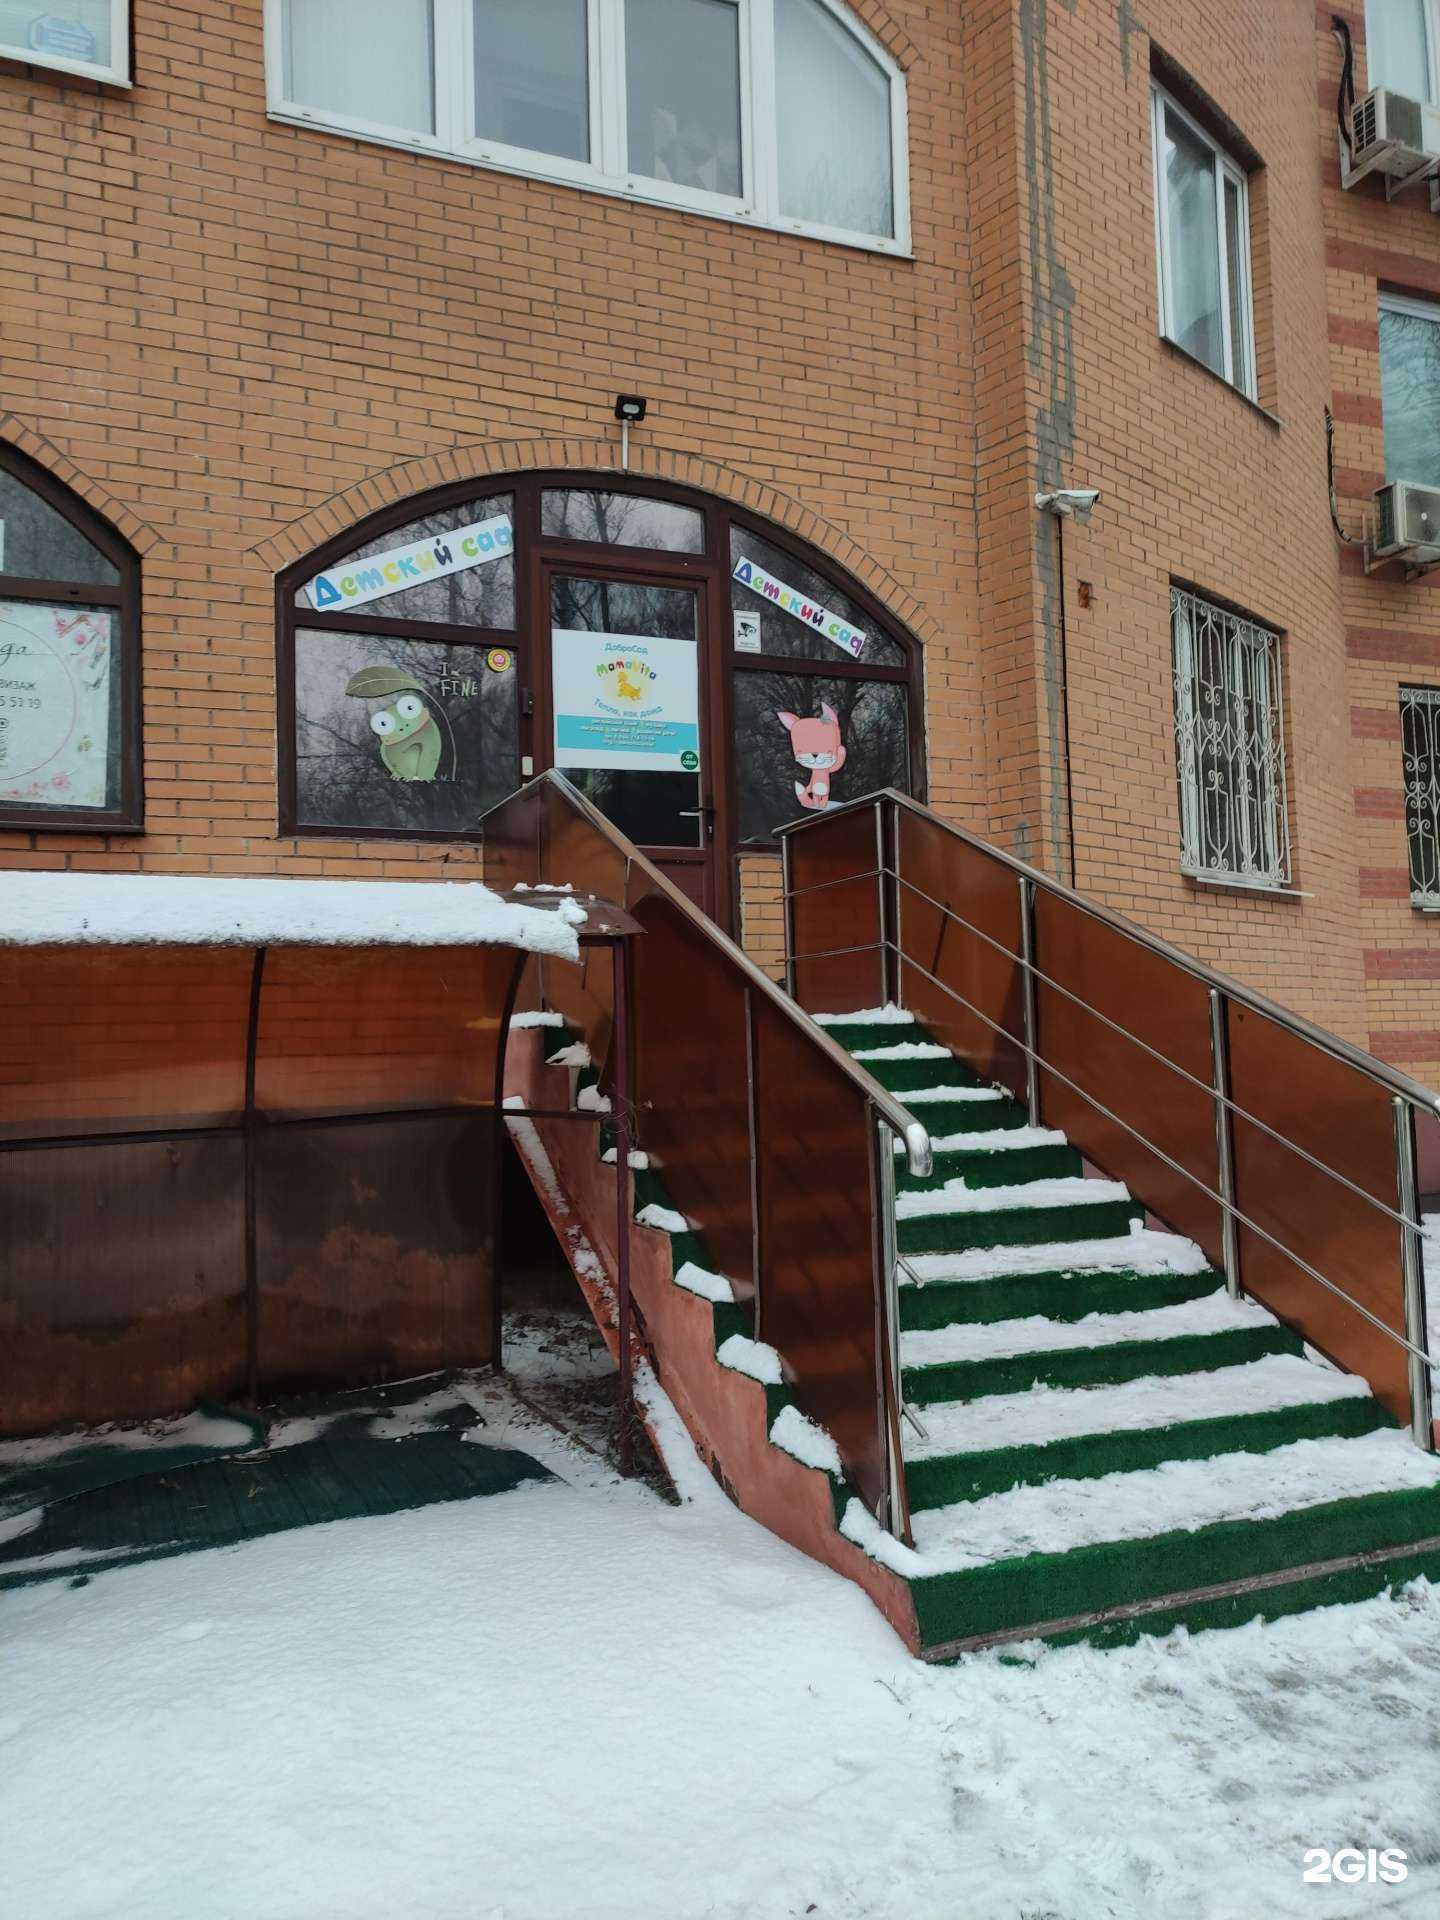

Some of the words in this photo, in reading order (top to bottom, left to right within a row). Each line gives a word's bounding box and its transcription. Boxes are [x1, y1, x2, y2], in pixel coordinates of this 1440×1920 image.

[315, 537, 453, 608] Детский
[735, 562, 825, 627] Детский
[828, 623, 863, 655] сад
[440, 679, 479, 697] FINE
